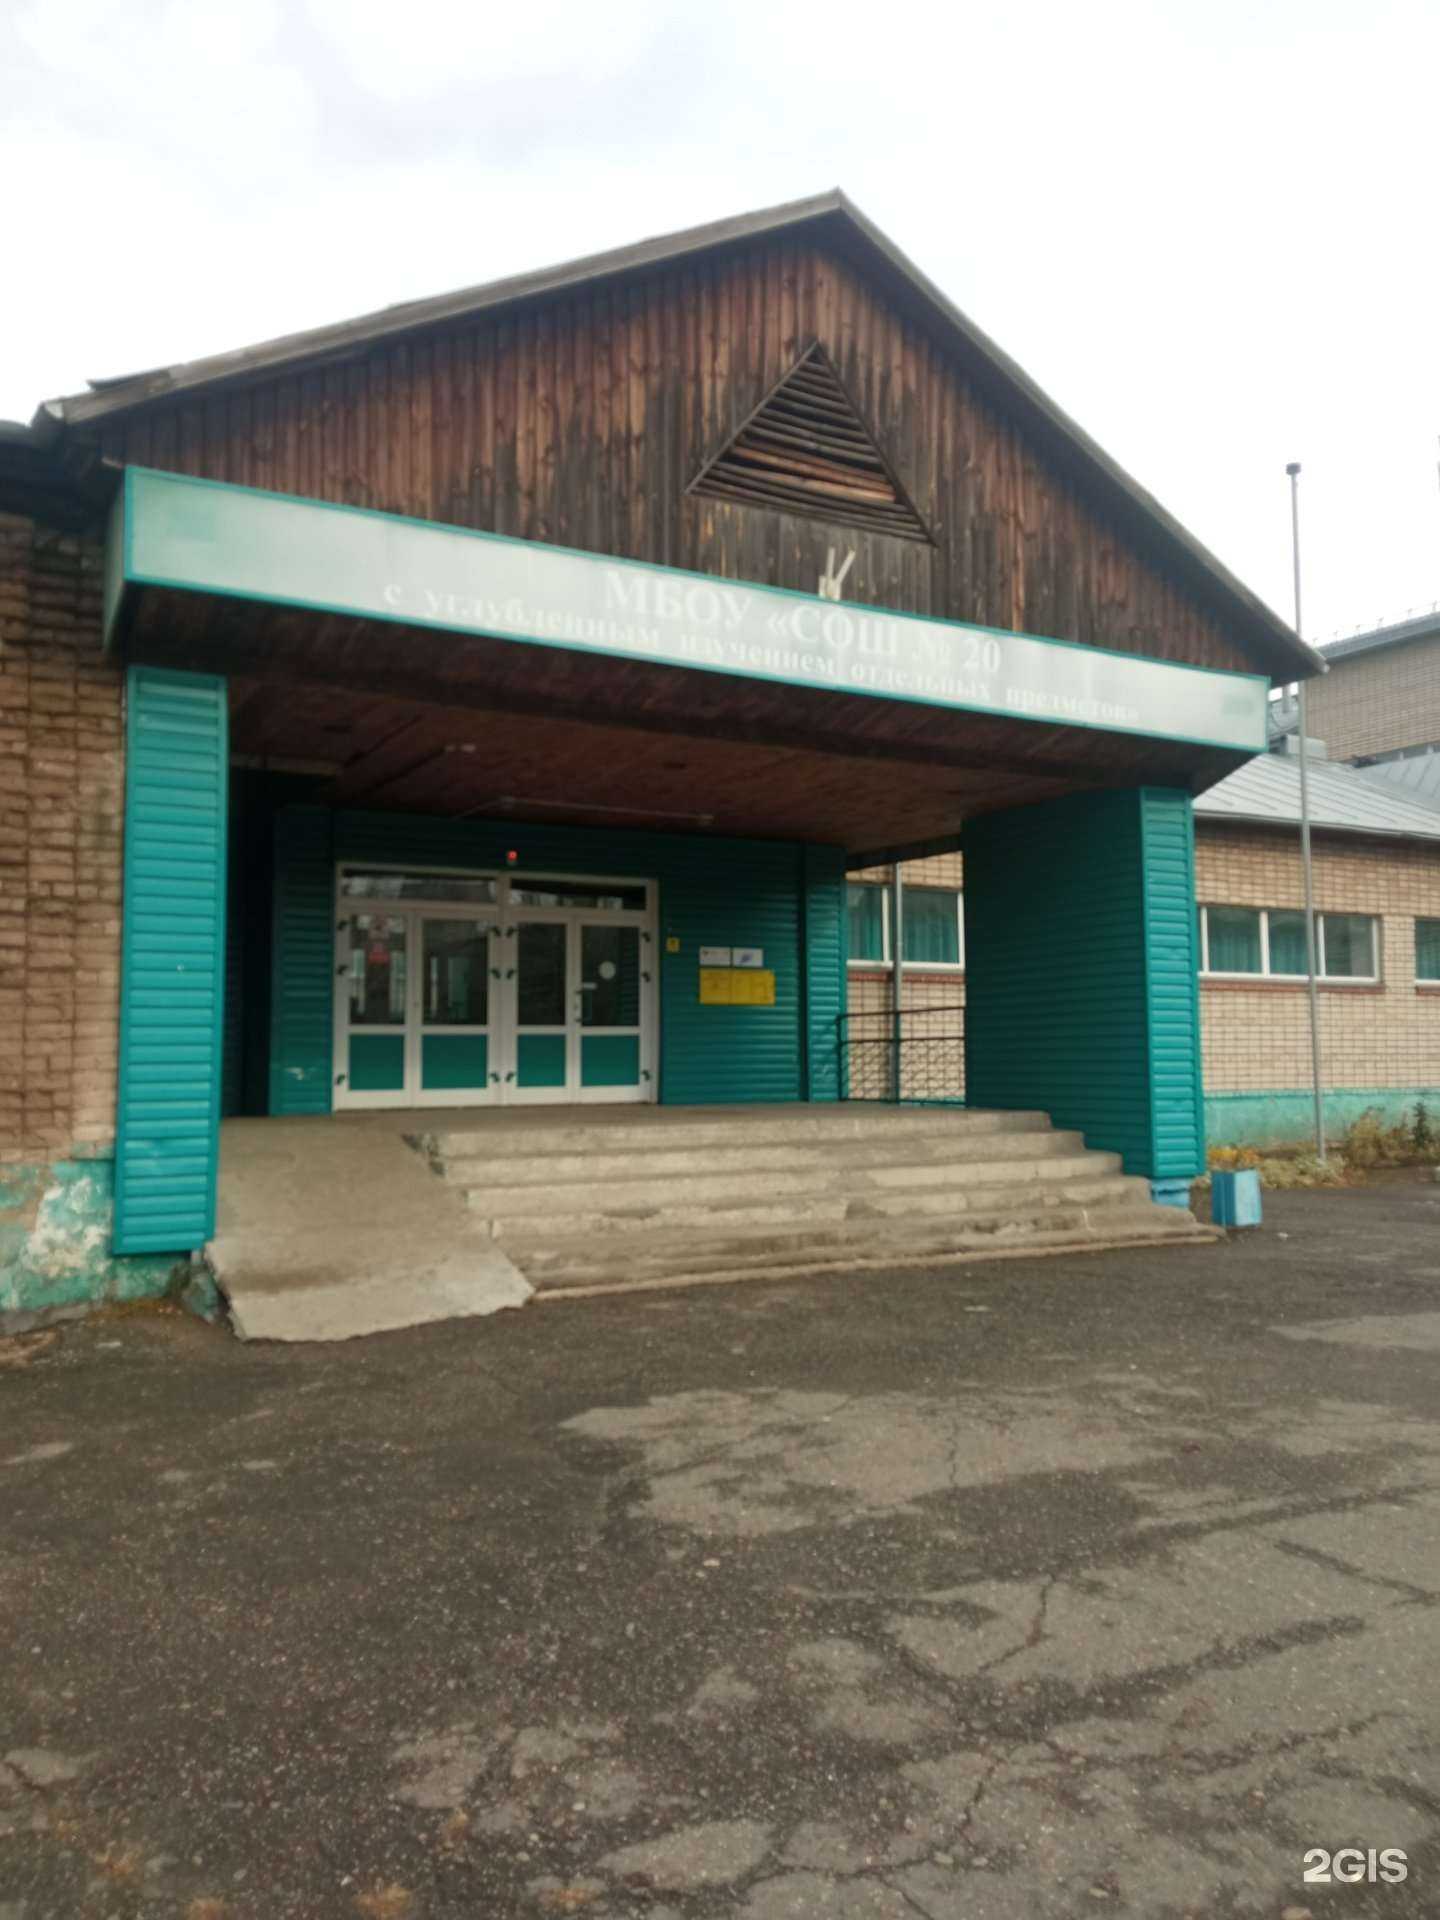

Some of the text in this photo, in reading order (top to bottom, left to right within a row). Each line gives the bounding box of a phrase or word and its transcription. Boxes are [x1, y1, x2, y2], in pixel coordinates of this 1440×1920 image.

[604, 569, 752, 630] МБОУ
[766, 604, 897, 656] «СОШ
[962, 635, 1001, 673] 20
